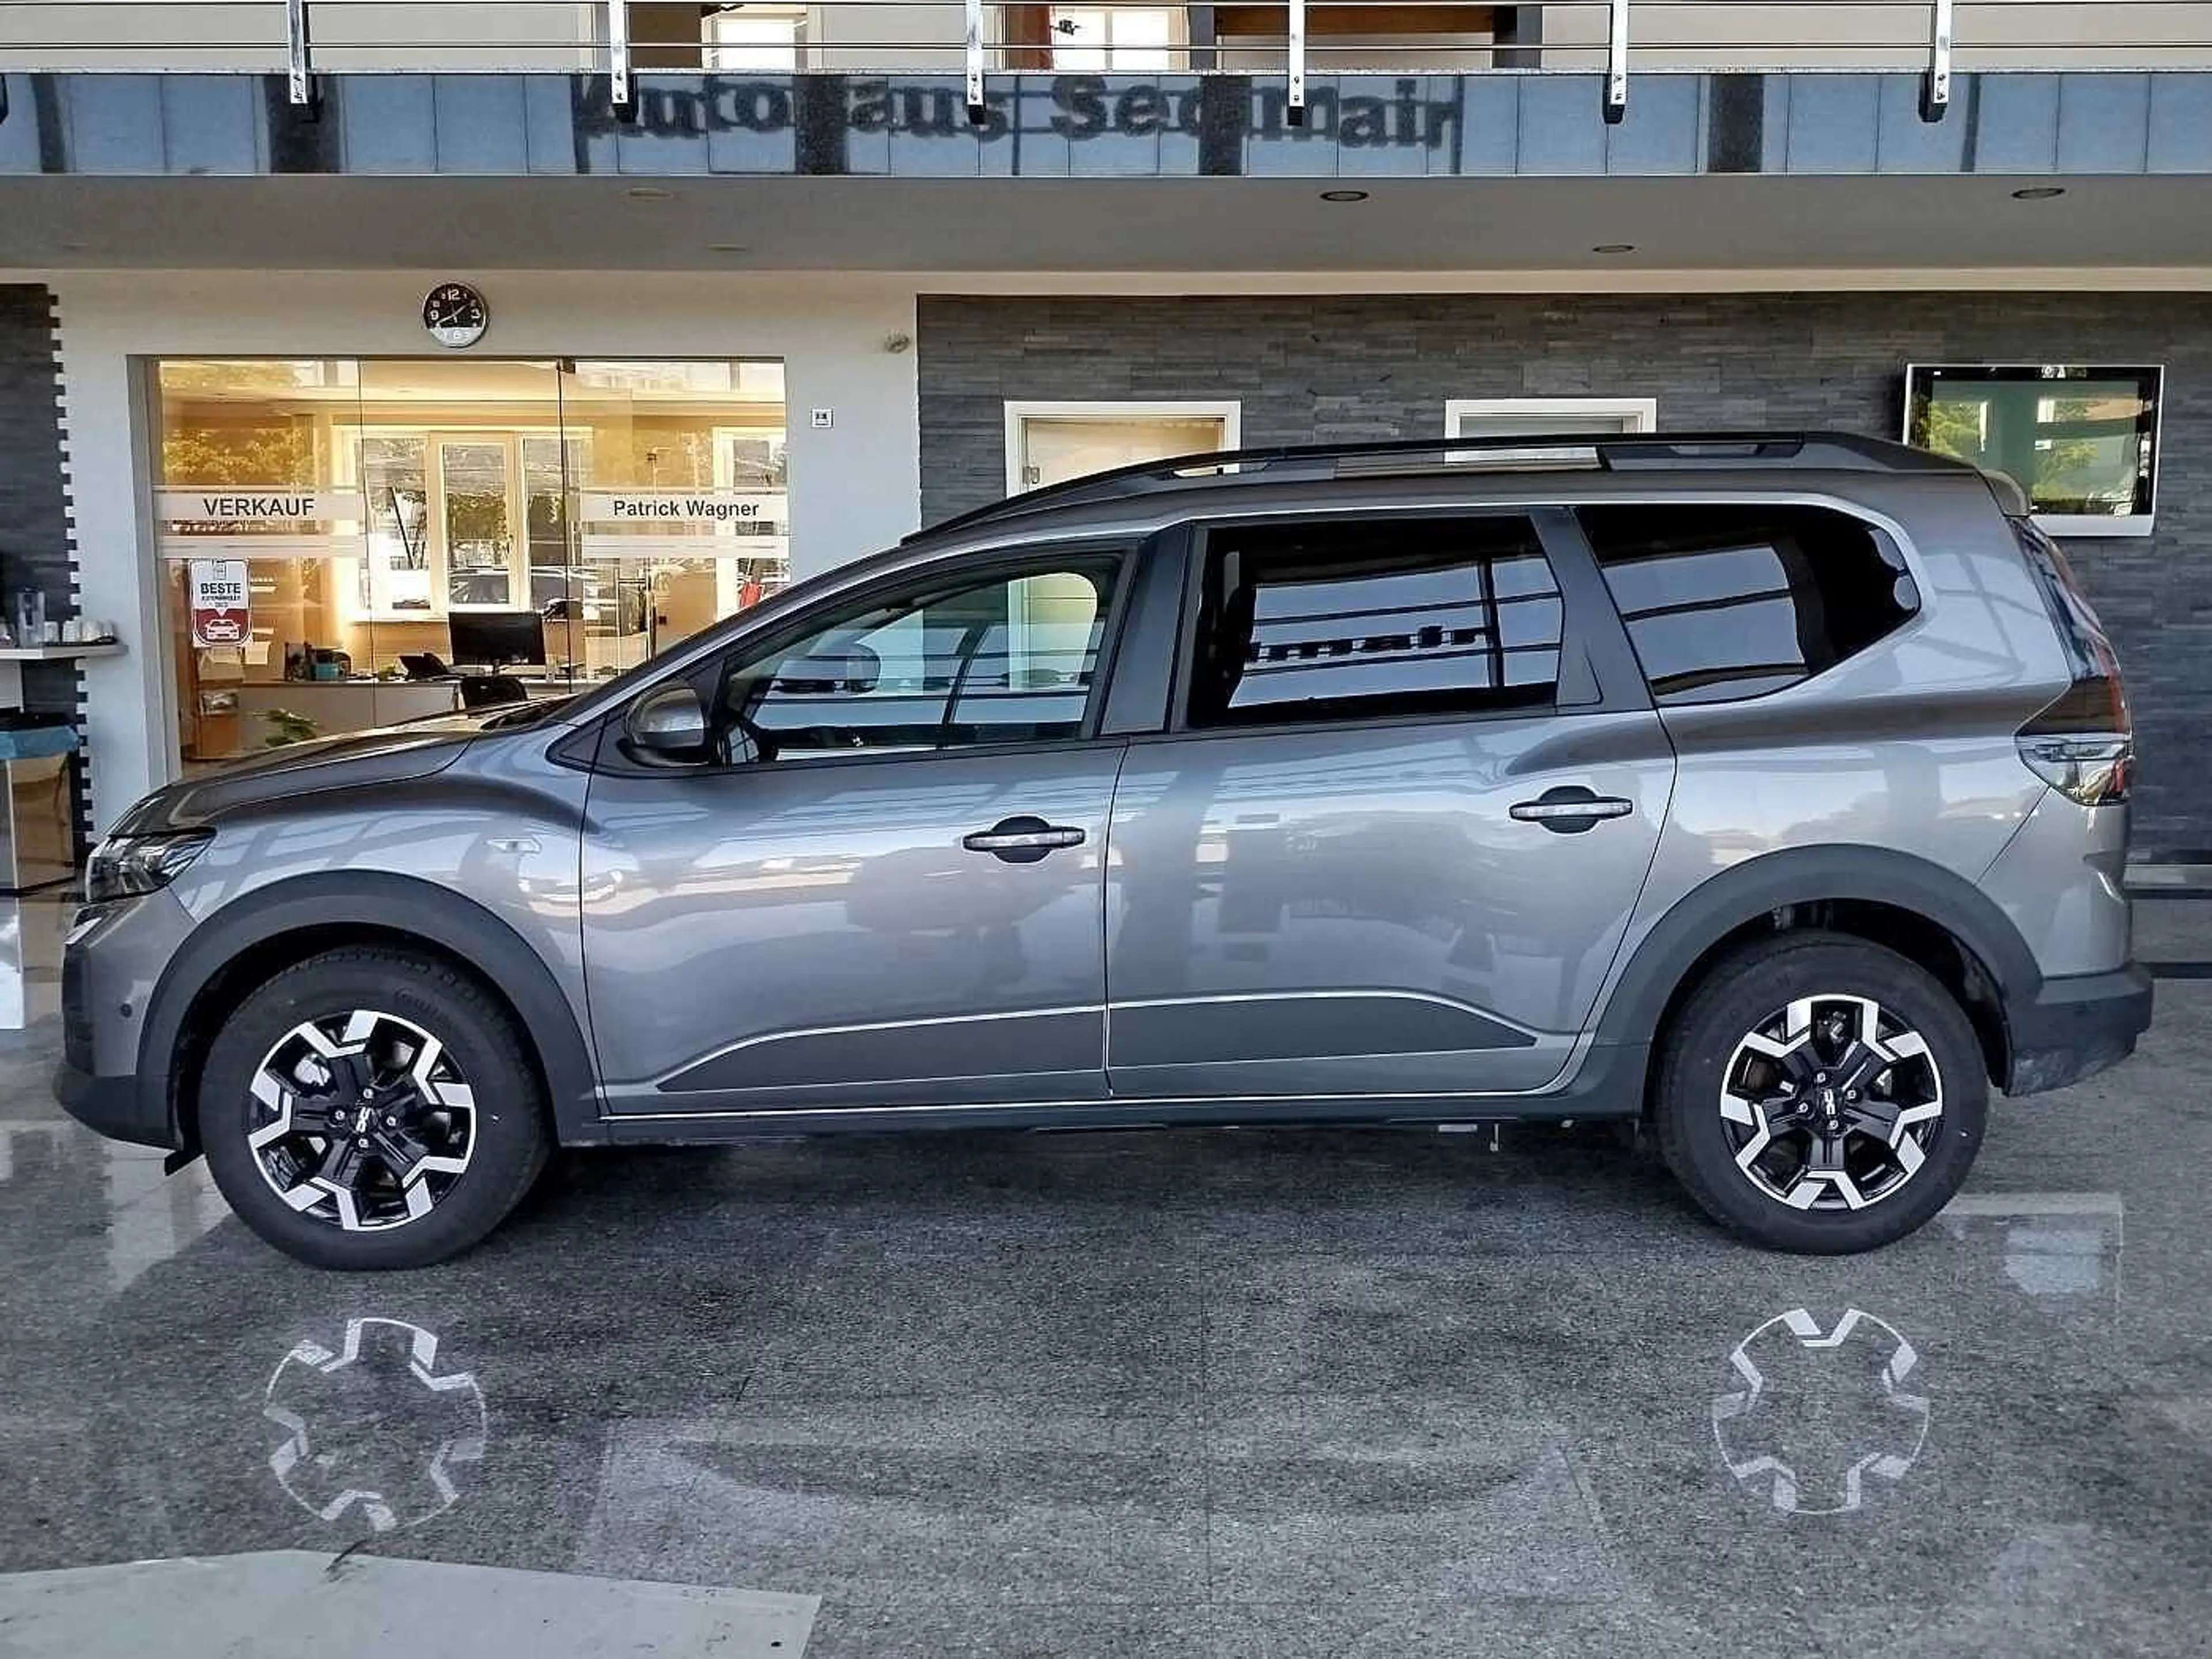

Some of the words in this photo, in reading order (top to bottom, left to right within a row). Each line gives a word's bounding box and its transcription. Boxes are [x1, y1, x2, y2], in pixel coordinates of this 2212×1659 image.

[448, 288, 461, 301] 12
[203, 498, 315, 516] VERKAUF
[614, 499, 680, 516] Patrick
[685, 500, 760, 521] Wagner
[200, 582, 241, 594] BESTE
